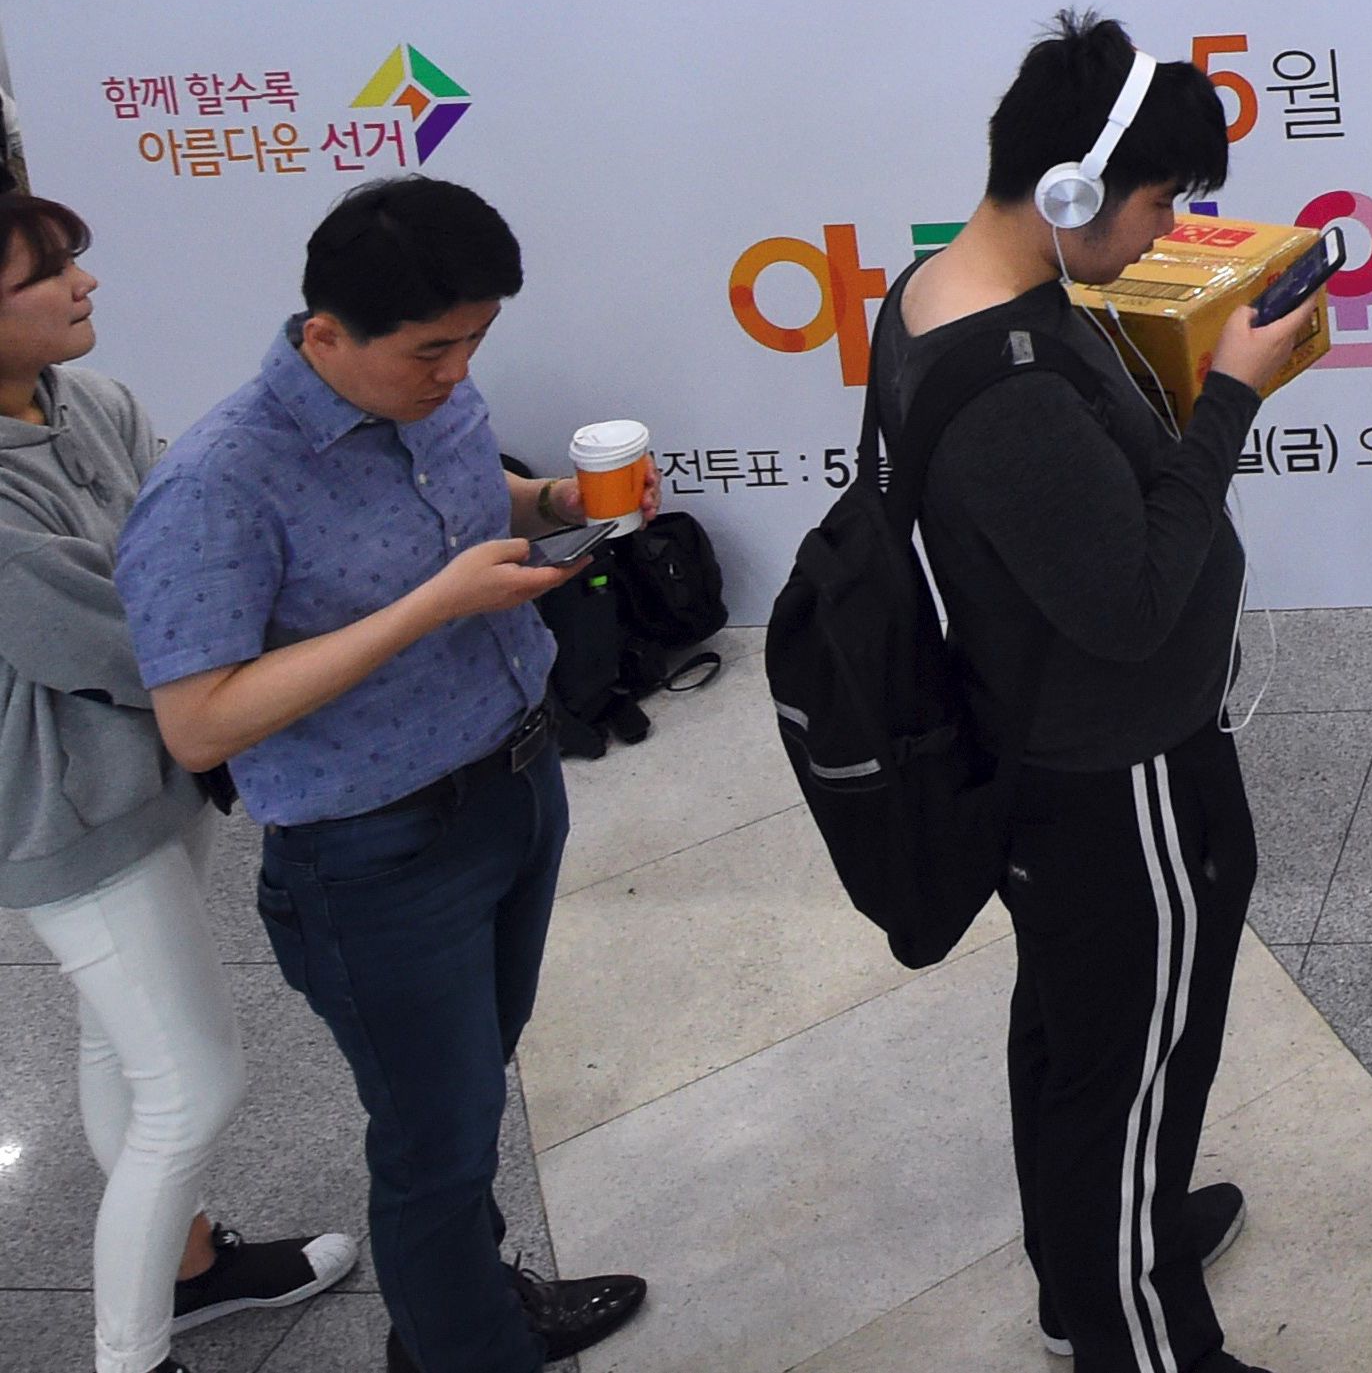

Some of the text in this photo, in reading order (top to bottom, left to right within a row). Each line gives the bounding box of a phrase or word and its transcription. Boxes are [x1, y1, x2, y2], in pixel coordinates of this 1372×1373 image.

[102, 71, 300, 119] 함께 할수록
[138, 119, 407, 177] 아름다운 선거
[649, 448, 789, 495] 전투표
